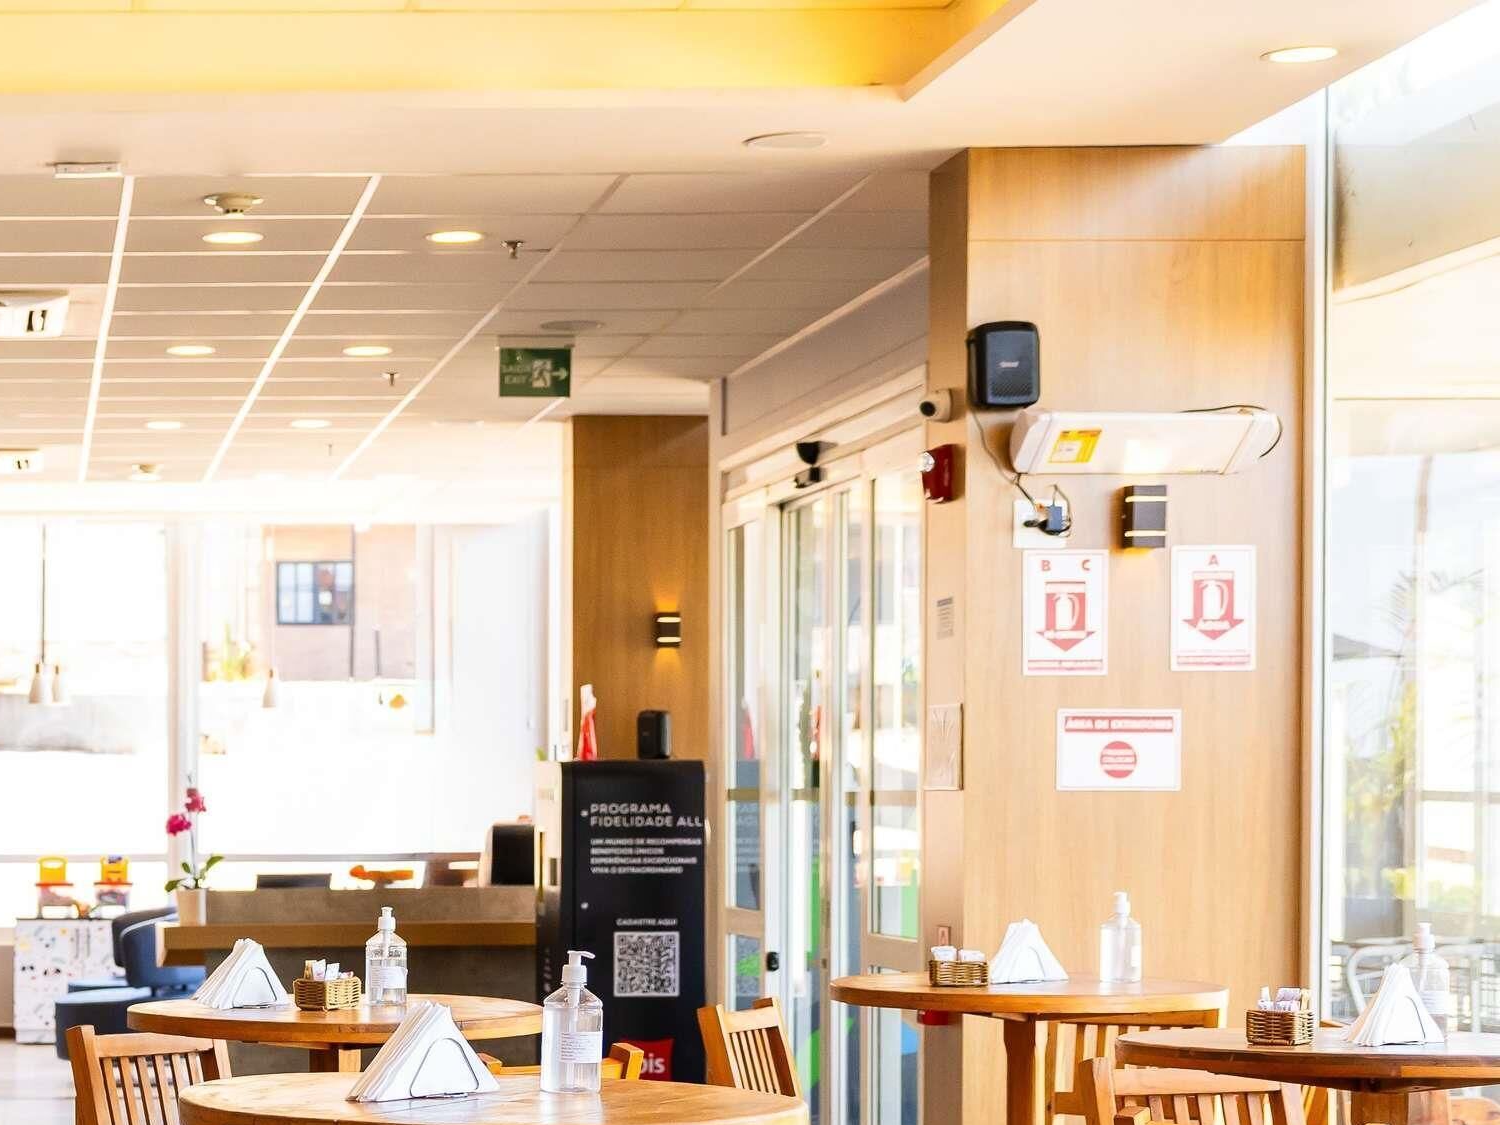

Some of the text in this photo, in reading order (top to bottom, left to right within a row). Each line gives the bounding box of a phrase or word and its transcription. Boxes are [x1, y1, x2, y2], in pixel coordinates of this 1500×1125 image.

[1041, 559, 1091, 571] B C
[1208, 554, 1219, 566] A
[590, 803, 672, 814] PROGRAMA
[590, 815, 703, 827] FIDELIDADE ALL
[605, 838, 633, 846] MUNDO
[634, 838, 644, 846] DE
[646, 838, 702, 846] RECOMPENSAS
[610, 866, 617, 874] O
[616, 918, 678, 926] CADASTRE AQUI
